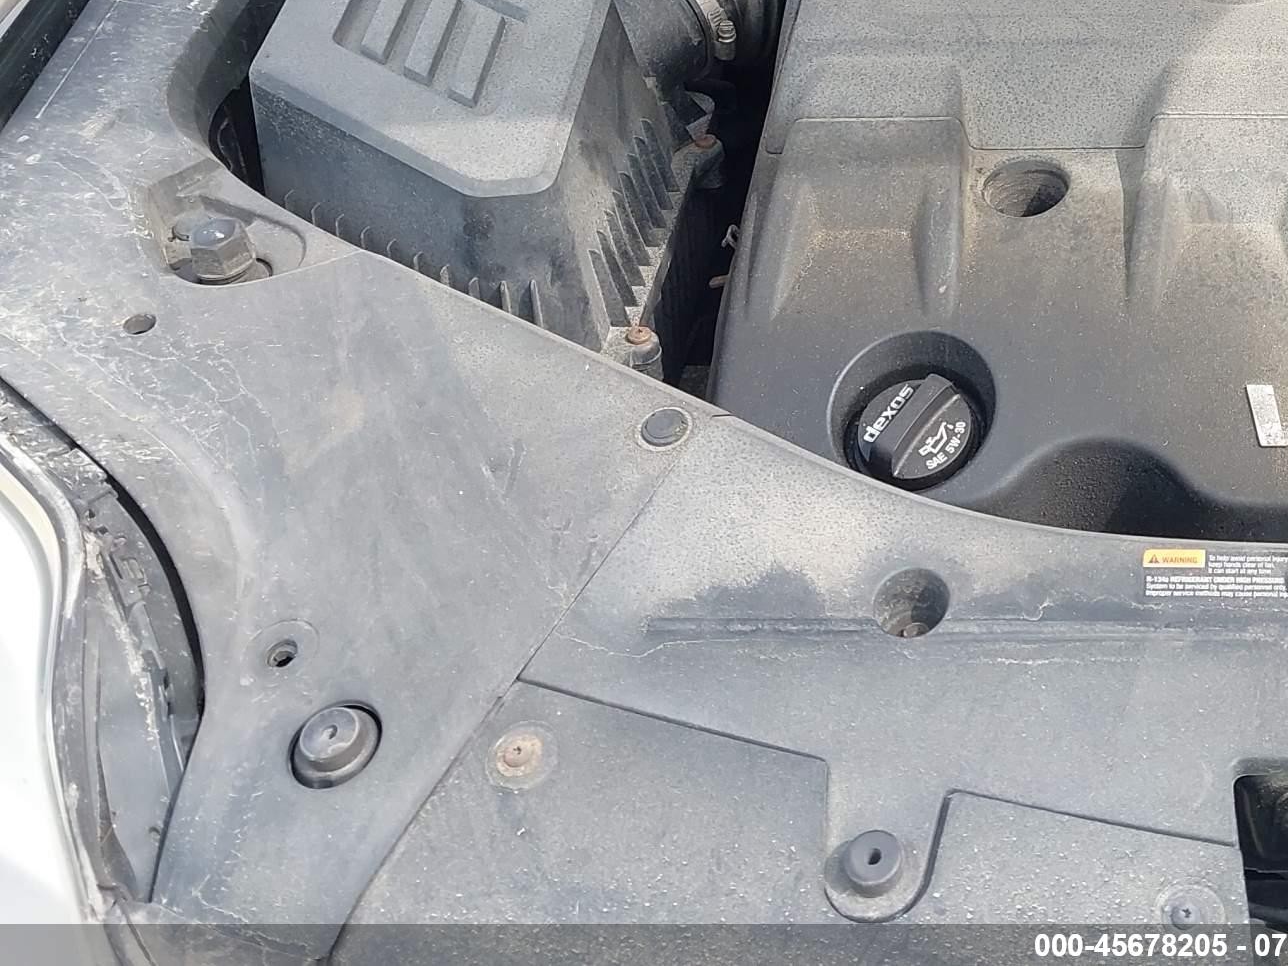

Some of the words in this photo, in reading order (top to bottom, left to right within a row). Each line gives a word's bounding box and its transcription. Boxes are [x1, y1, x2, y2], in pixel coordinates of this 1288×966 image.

[863, 383, 915, 444] dexos
[926, 452, 948, 470] SAE
[944, 421, 967, 454] 5W-30
[1161, 556, 1198, 564] WARNING
